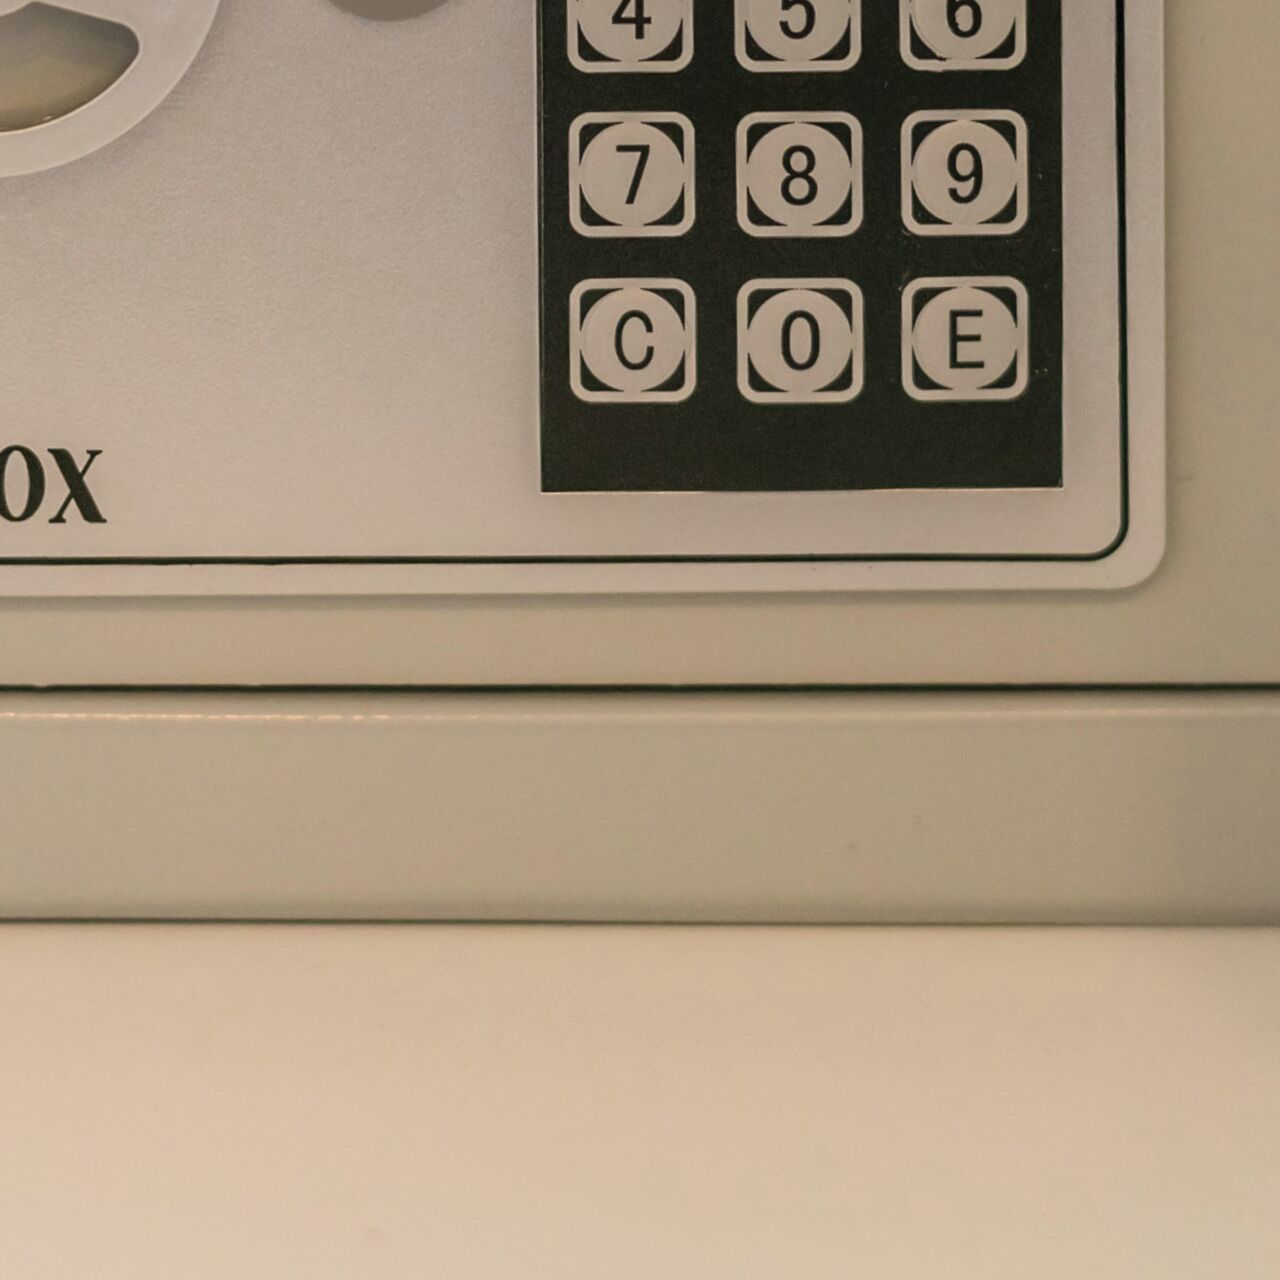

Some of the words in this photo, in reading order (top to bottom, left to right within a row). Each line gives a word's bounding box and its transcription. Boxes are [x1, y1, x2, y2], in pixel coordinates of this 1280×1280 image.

[615, 143, 651, 205] 7
[780, 144, 819, 207] 8
[946, 142, 984, 205] 9
[614, 309, 655, 371] C
[948, 308, 985, 370] E
